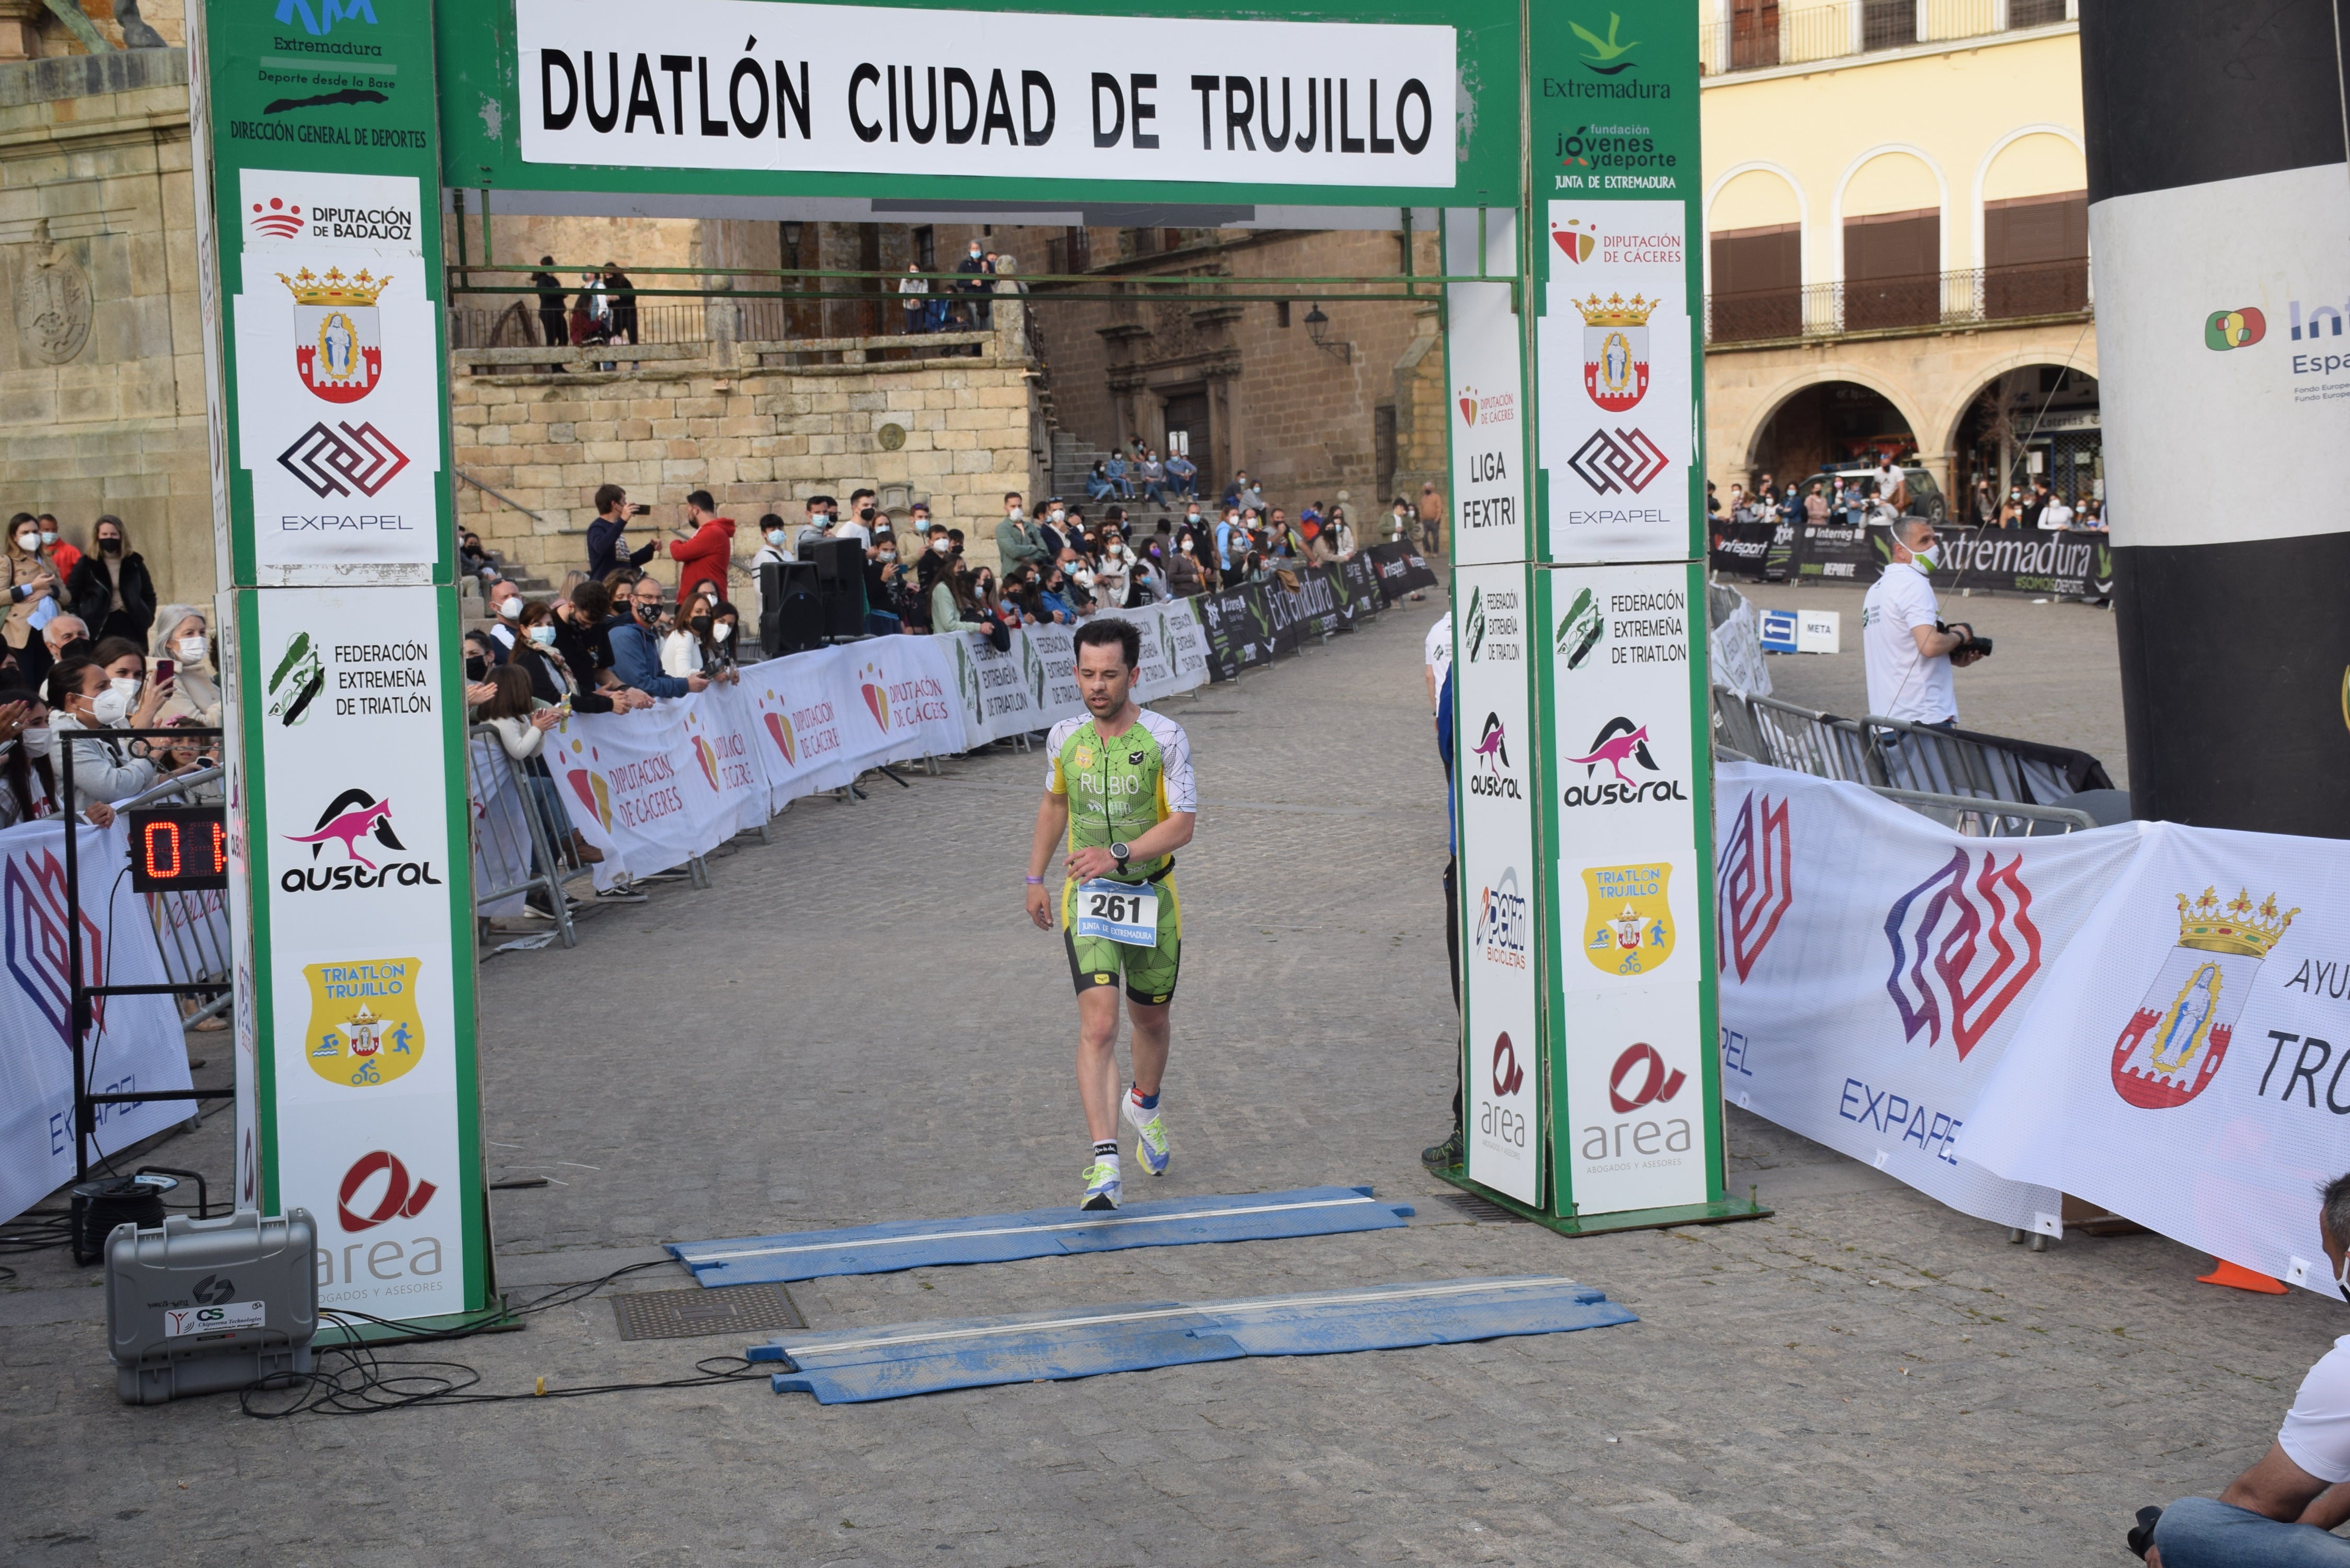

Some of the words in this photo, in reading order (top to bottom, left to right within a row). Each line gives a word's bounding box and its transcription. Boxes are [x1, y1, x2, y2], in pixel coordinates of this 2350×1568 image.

[274, 37, 382, 56] Extremadura
[259, 71, 307, 85] Deporte
[313, 74, 348, 86] desde
[353, 76, 363, 87] la
[369, 77, 395, 89] Base
[1543, 78, 1671, 99] Extremadura
[541, 34, 811, 140] DUATLÓN
[848, 62, 1056, 146] CIUDAD
[1091, 72, 1159, 148] DE
[1191, 75, 1432, 155] TRUJILLO
[231, 120, 294, 142] DIRECCIÓN
[298, 125, 350, 145] GENERAL
[355, 129, 368, 146] DE
[372, 130, 426, 148] DEPORTES
[1591, 124, 1649, 134] fundación
[1556, 126, 1654, 157] jóvenes
[1556, 176, 1583, 189] JUNTA
[1588, 176, 1600, 188] DE
[1605, 176, 1676, 188] EXTREMADURA
[313, 207, 411, 225] DIPUTACIÓN
[314, 226, 328, 237] DE
[334, 224, 411, 240] BADAJOZ
[1604, 234, 1680, 247] DIPUTACIÓN
[1604, 251, 1619, 262] DE
[1624, 249, 1680, 262] CÁCERES
[1481, 391, 1513, 410] DIPUTACIÓN
[1481, 413, 1488, 424] DE
[1490, 409, 1514, 423] CÁCERES
[1471, 452, 1506, 483] LIGA
[282, 515, 413, 531] EXPAPEL
[1464, 496, 1515, 529] FEXTRI
[1570, 510, 1670, 524] EXPAPEL
[1934, 531, 2091, 577] xtremadura
[1487, 589, 1518, 609] FEDERACIÓN
[1611, 590, 1684, 613] FEDERACIÓN
[1614, 617, 1683, 638] EXTREMEÑA
[1807, 624, 1831, 635] META
[335, 640, 428, 663] FEDERACIÓN
[1489, 644, 1495, 660] DE
[1612, 647, 1627, 664] DE
[1630, 644, 1686, 663] TRIATLON
[339, 668, 426, 689] EXTREMEÑA
[337, 698, 355, 715] DE
[360, 692, 431, 714] TRIATLÓN
[792, 698, 834, 732] DIPUTACIÓN
[800, 739, 812, 759] DE
[609, 752, 674, 795] DIPUTACIÓN
[1081, 773, 1139, 794] RUBIO
[1471, 775, 1522, 800] austral
[1564, 780, 1688, 808] austral
[619, 803, 636, 828] DE
[636, 786, 683, 825] CÁCERES
[281, 861, 442, 893] austral
[1598, 883, 1658, 898] TRUJILLO
[1090, 894, 1140, 924] 261
[1111, 928, 1152, 940] EXTREMADURA
[1487, 947, 1525, 970] BICICLETAS
[322, 963, 405, 982] TRIATLÓN
[2284, 959, 2350, 1001] AYU
[326, 981, 402, 999] TRUJILLO
[1481, 1101, 1524, 1147] area
[1582, 1119, 1690, 1160] area
[1587, 1163, 1631, 1174] ABOGADOS
[1643, 1158, 1681, 1168] ASESORES
[317, 1237, 442, 1287] area
[318, 1289, 368, 1304] OGADOS
[386, 1282, 443, 1295] ASESORES
[197, 1308, 224, 1321] CS
